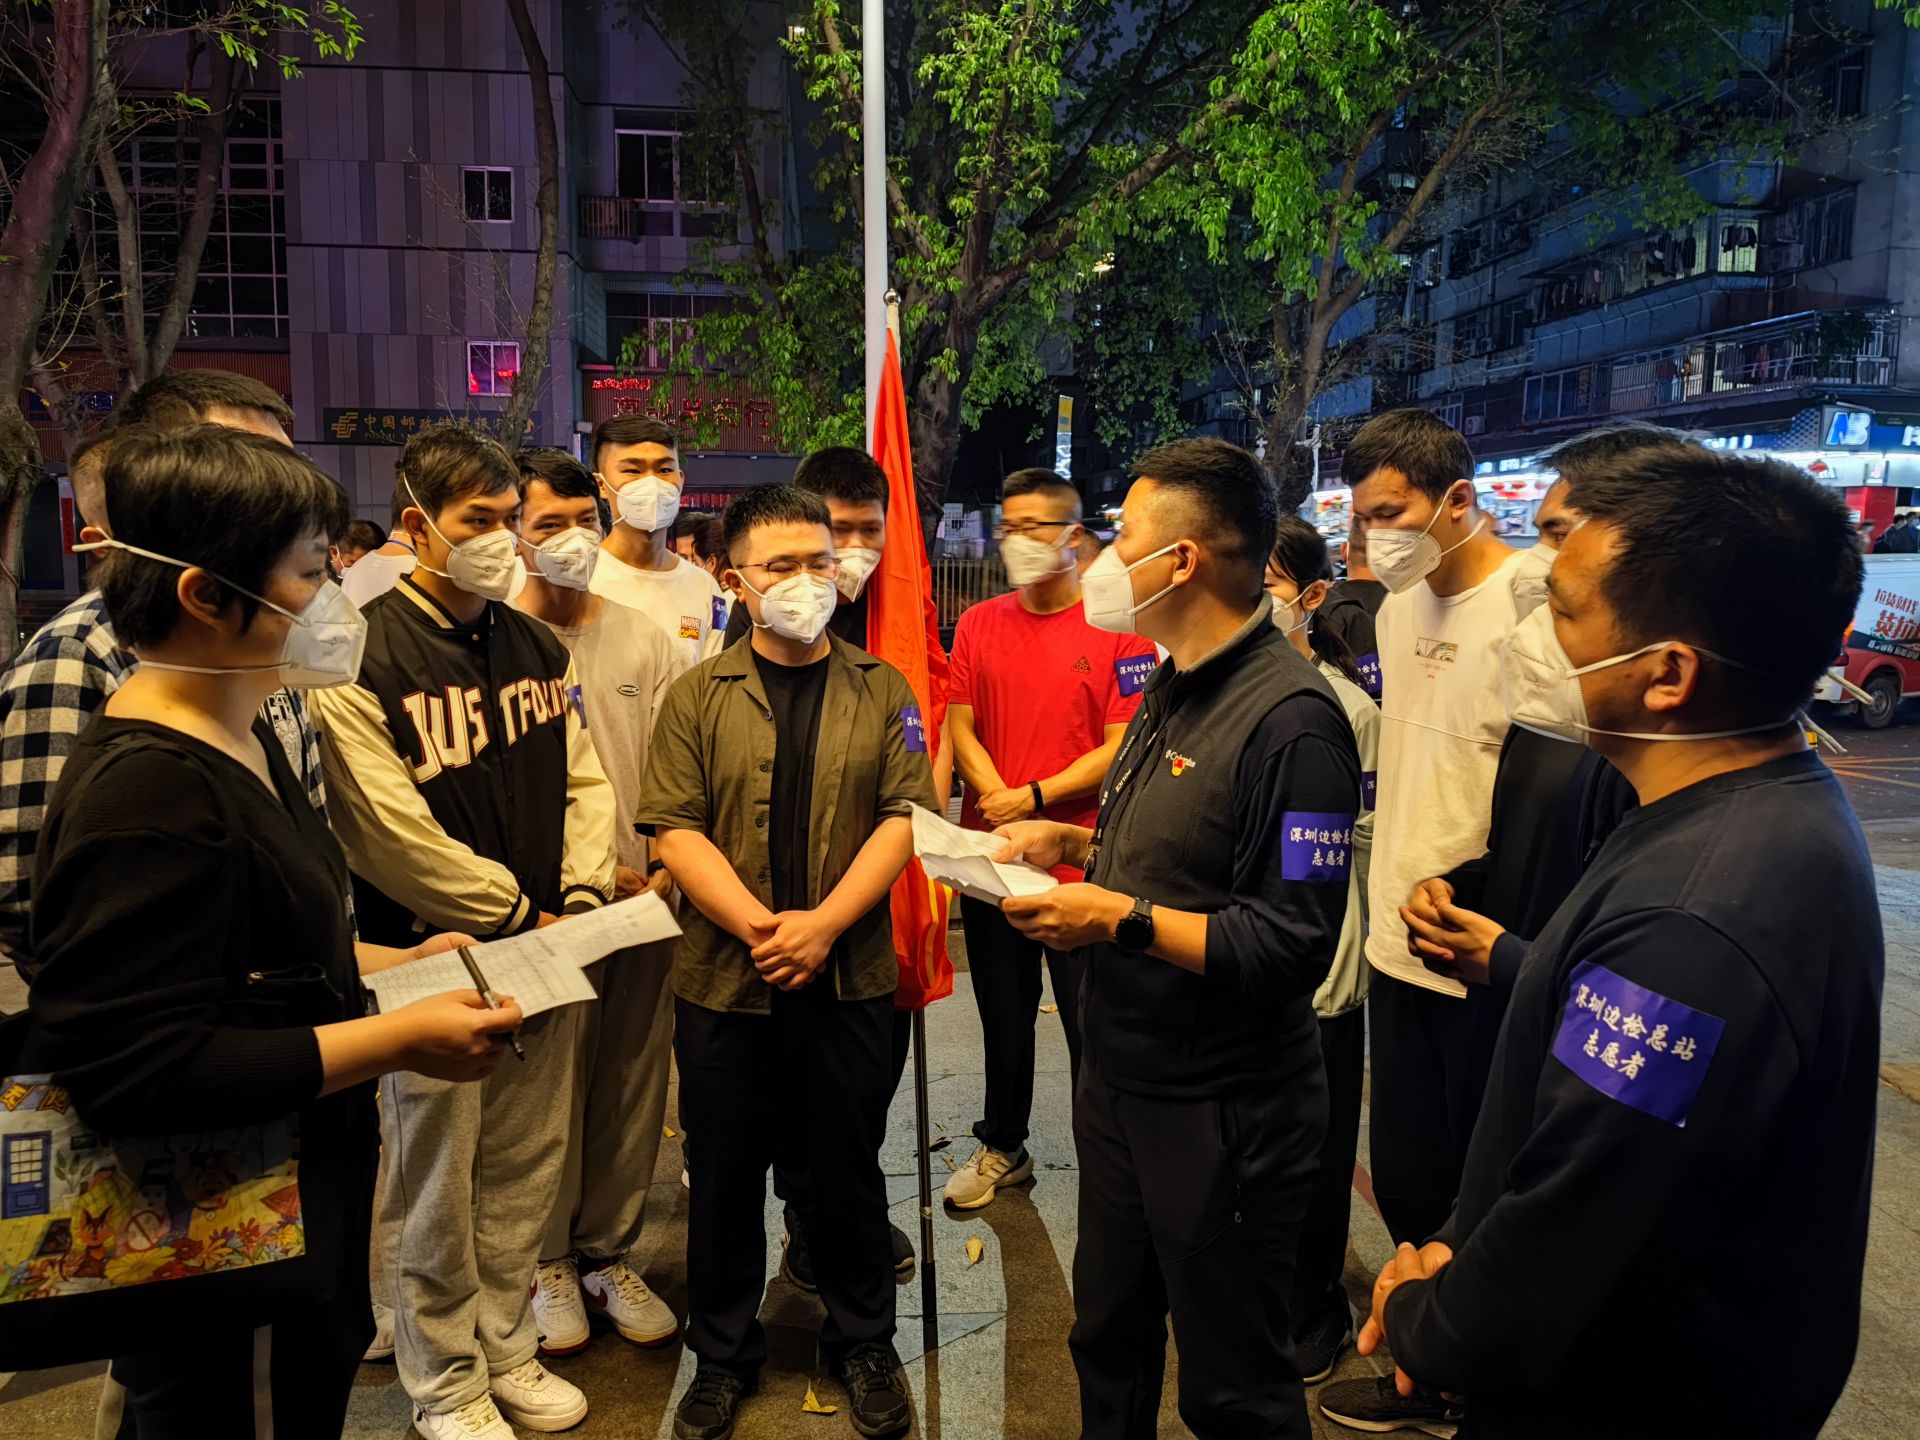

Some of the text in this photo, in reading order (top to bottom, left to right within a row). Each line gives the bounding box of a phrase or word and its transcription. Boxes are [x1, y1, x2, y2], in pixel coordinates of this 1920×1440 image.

[1876, 609, 1920, 640] 货拉
[1312, 848, 1345, 866] 志愿者
[1575, 983, 1697, 1062] 深圳边检总站
[1583, 1028, 1647, 1080] 志愿者
